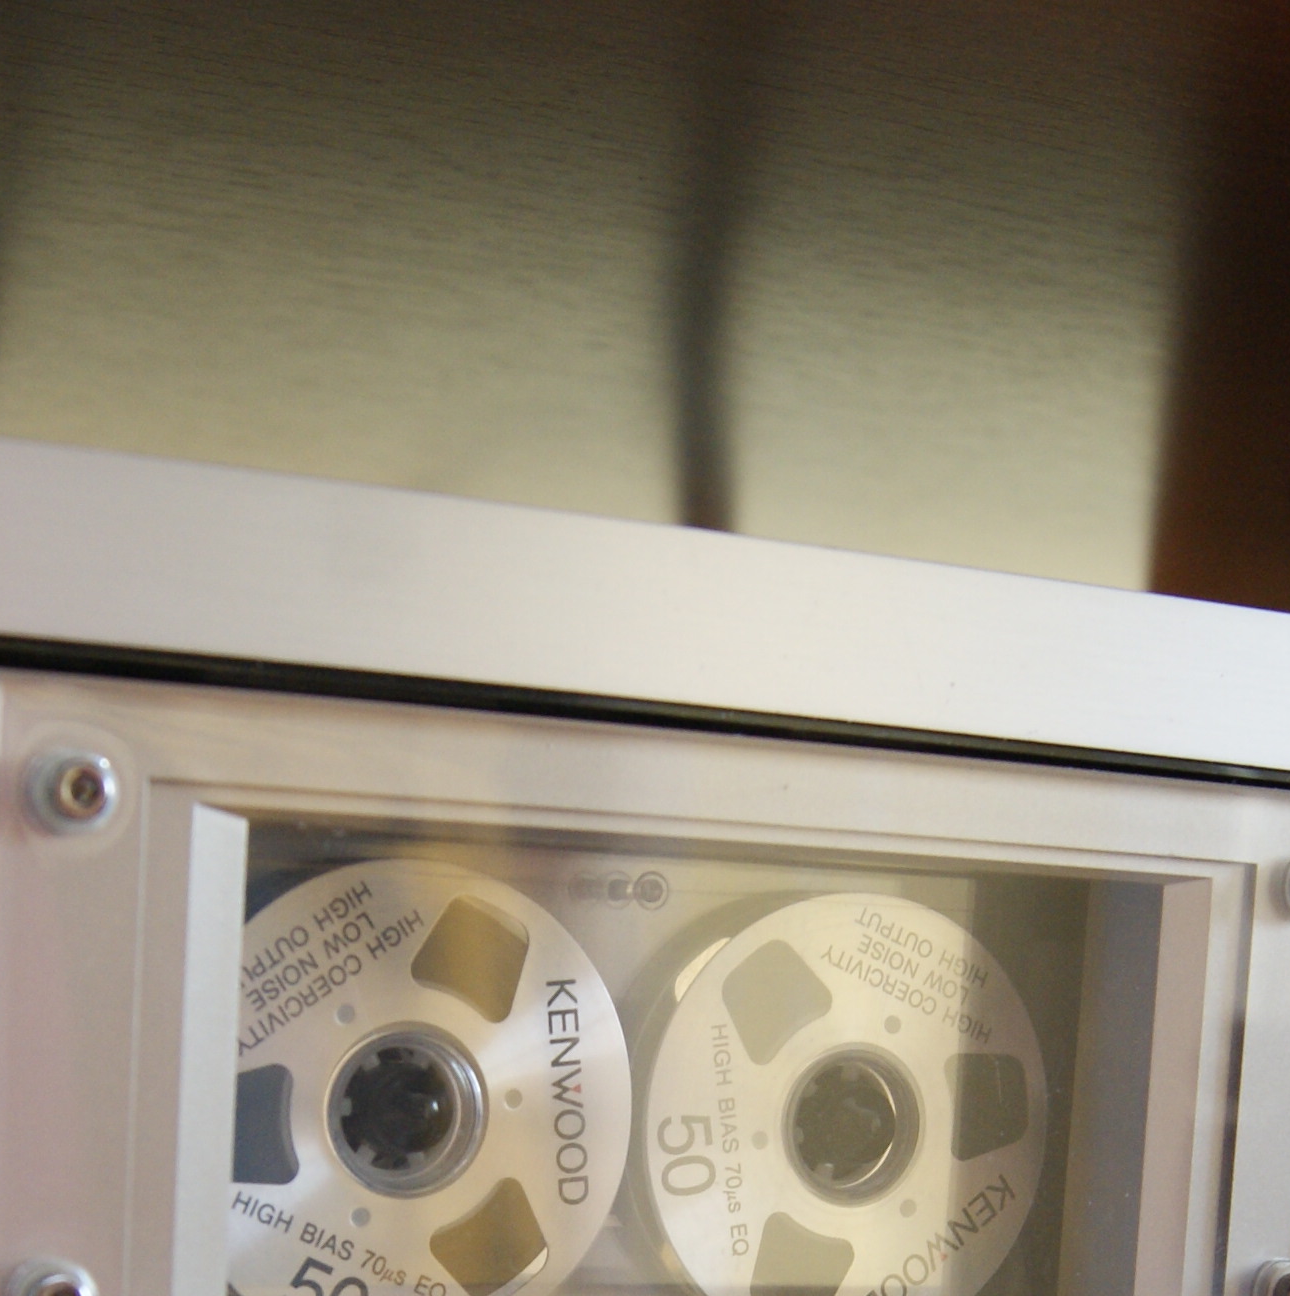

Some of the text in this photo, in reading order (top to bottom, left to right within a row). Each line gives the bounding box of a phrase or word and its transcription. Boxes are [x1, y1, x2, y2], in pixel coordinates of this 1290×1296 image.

[313, 880, 373, 931] HIGH
[366, 909, 425, 960] HIGH
[246, 912, 376, 1012] LOW NOISE
[854, 907, 989, 989] HIGH OUTPUT
[857, 934, 969, 1006] LOW NOISE
[820, 944, 992, 1044] HIGH COERCIVITY
[711, 1023, 732, 1087] HIGH
[546, 979, 589, 1206] KENWOOD
[717, 1097, 740, 1154] BIAS
[656, 1113, 717, 1197] 50
[231, 1191, 294, 1233] HIGH
[299, 1222, 354, 1262] BIAS
[729, 1222, 749, 1257] EQ
